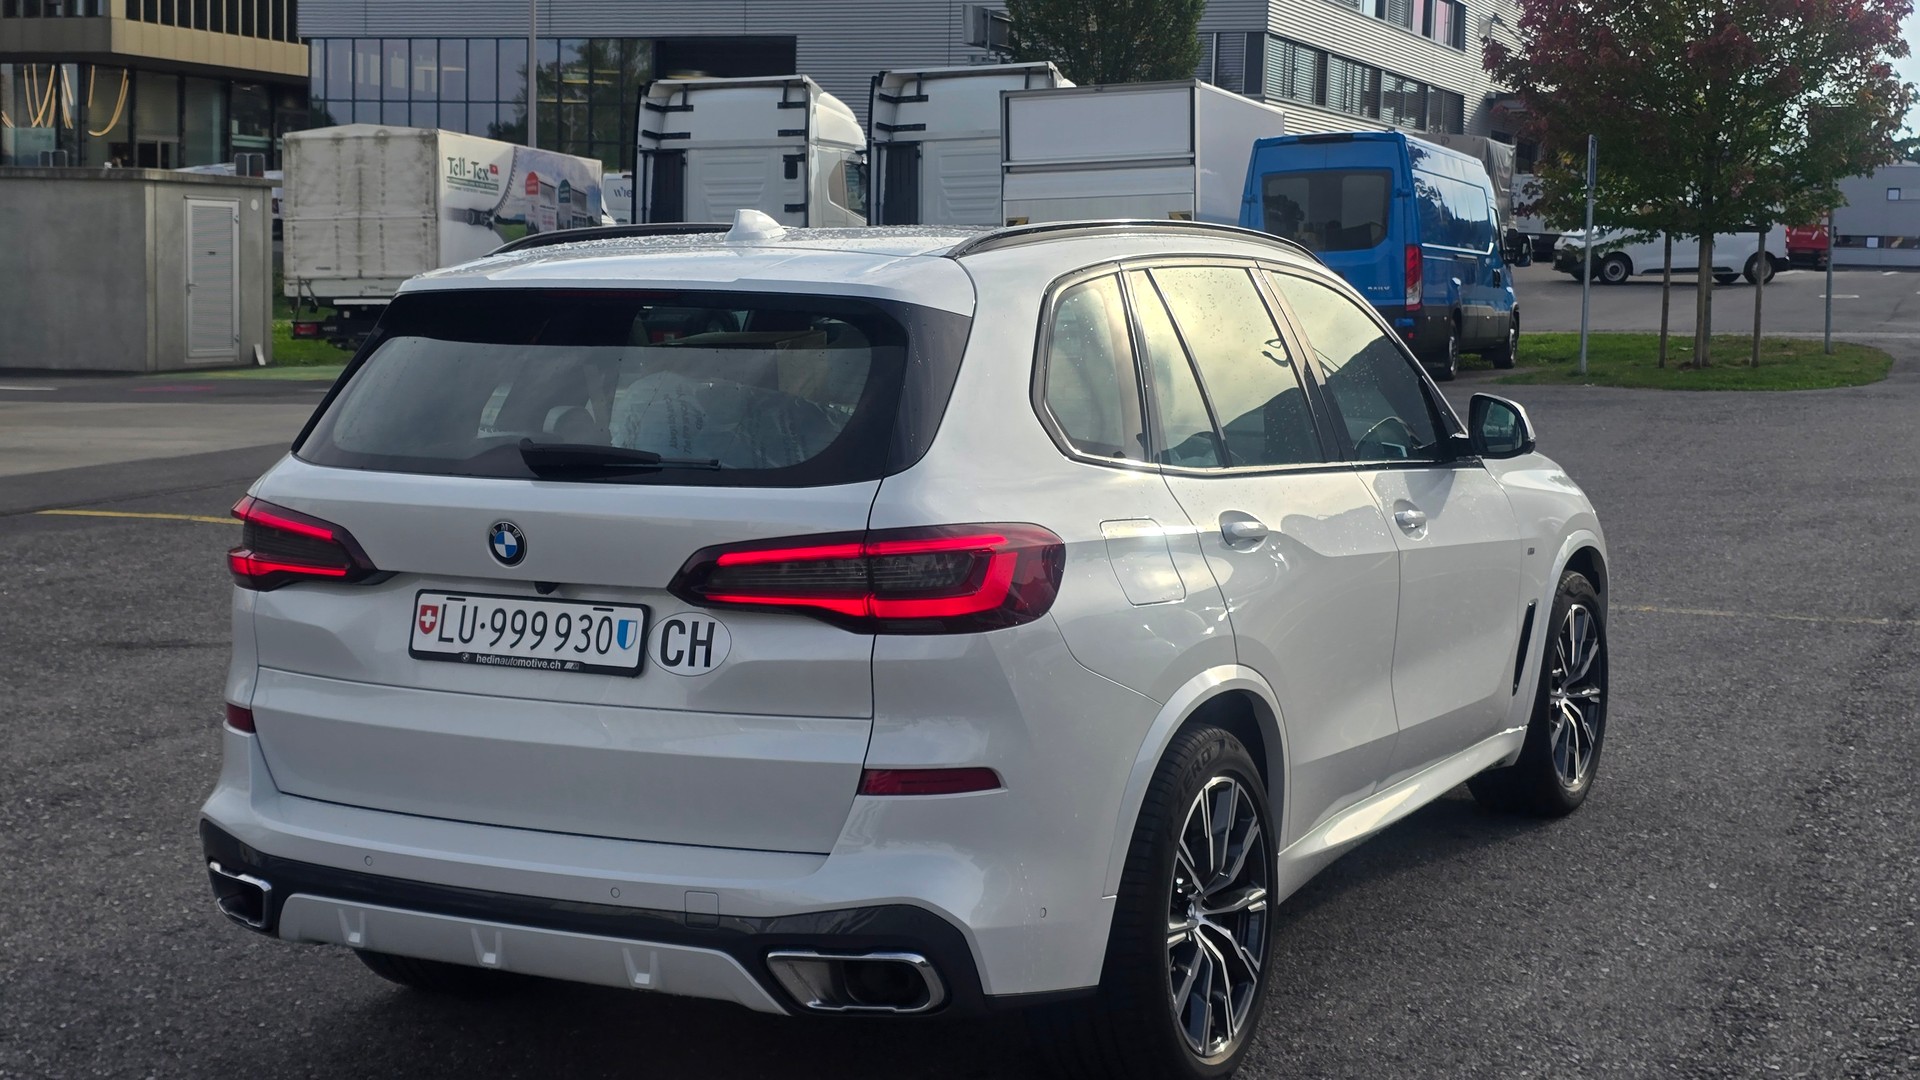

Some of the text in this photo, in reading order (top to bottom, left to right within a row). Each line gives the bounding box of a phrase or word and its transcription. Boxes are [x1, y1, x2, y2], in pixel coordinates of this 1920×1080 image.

[447, 157, 489, 181] Tell-Tex
[660, 619, 716, 668] CH
[476, 653, 561, 670] hedinautomotive.ch
